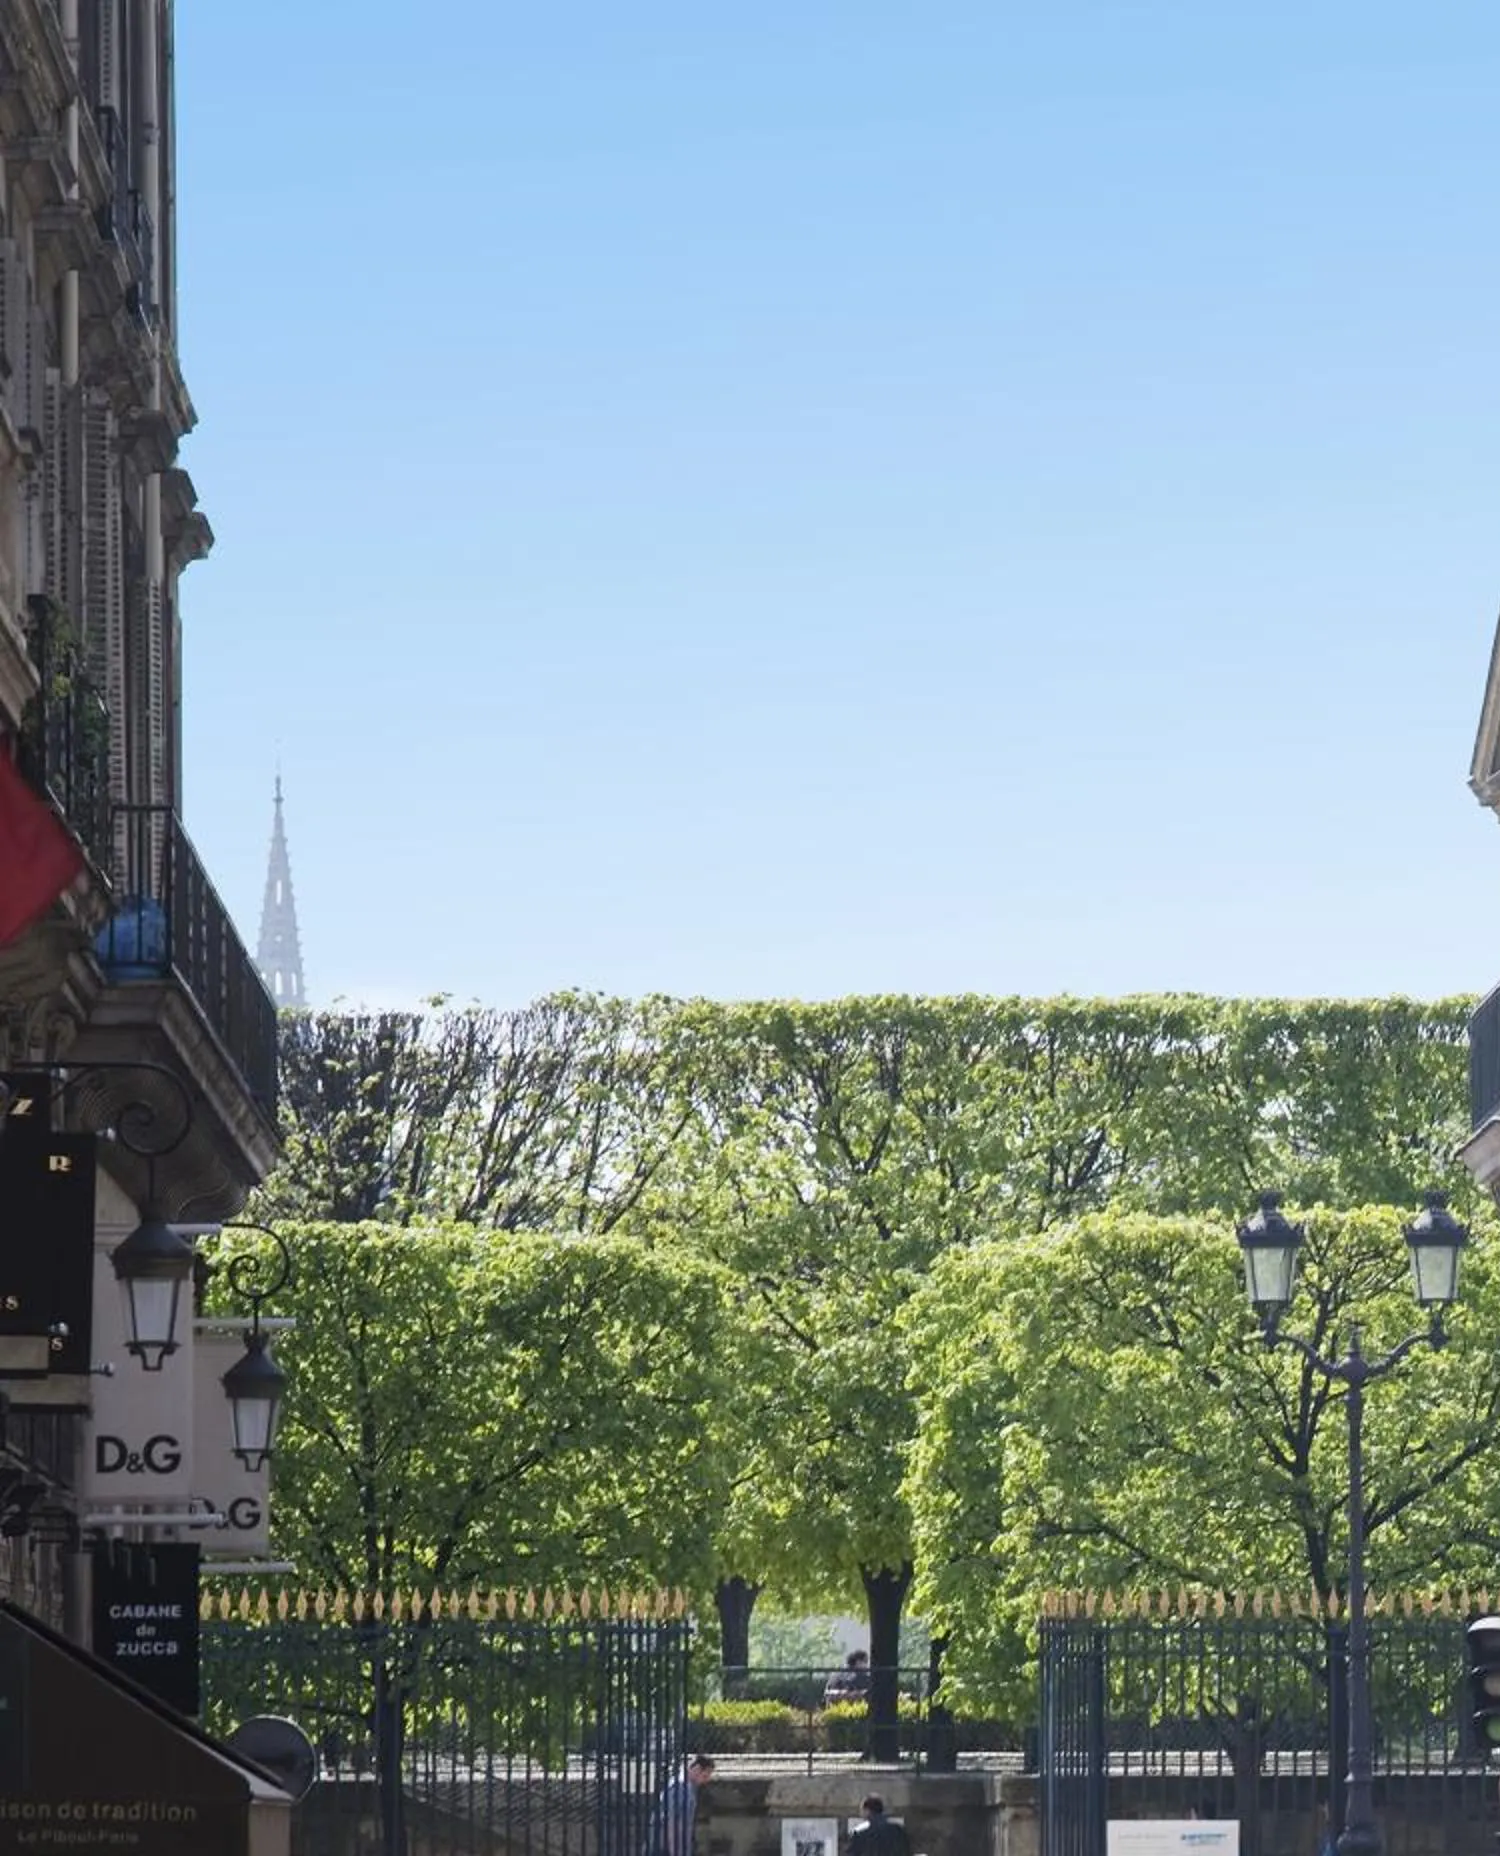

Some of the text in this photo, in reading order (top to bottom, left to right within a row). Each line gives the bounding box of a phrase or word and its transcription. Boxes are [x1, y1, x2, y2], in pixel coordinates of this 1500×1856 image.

[95, 1434, 182, 1475] D&G
[109, 1605, 183, 1619] CABANE
[135, 1623, 157, 1637] de
[57, 1800, 88, 1821] de
[92, 1800, 199, 1822] tradition
